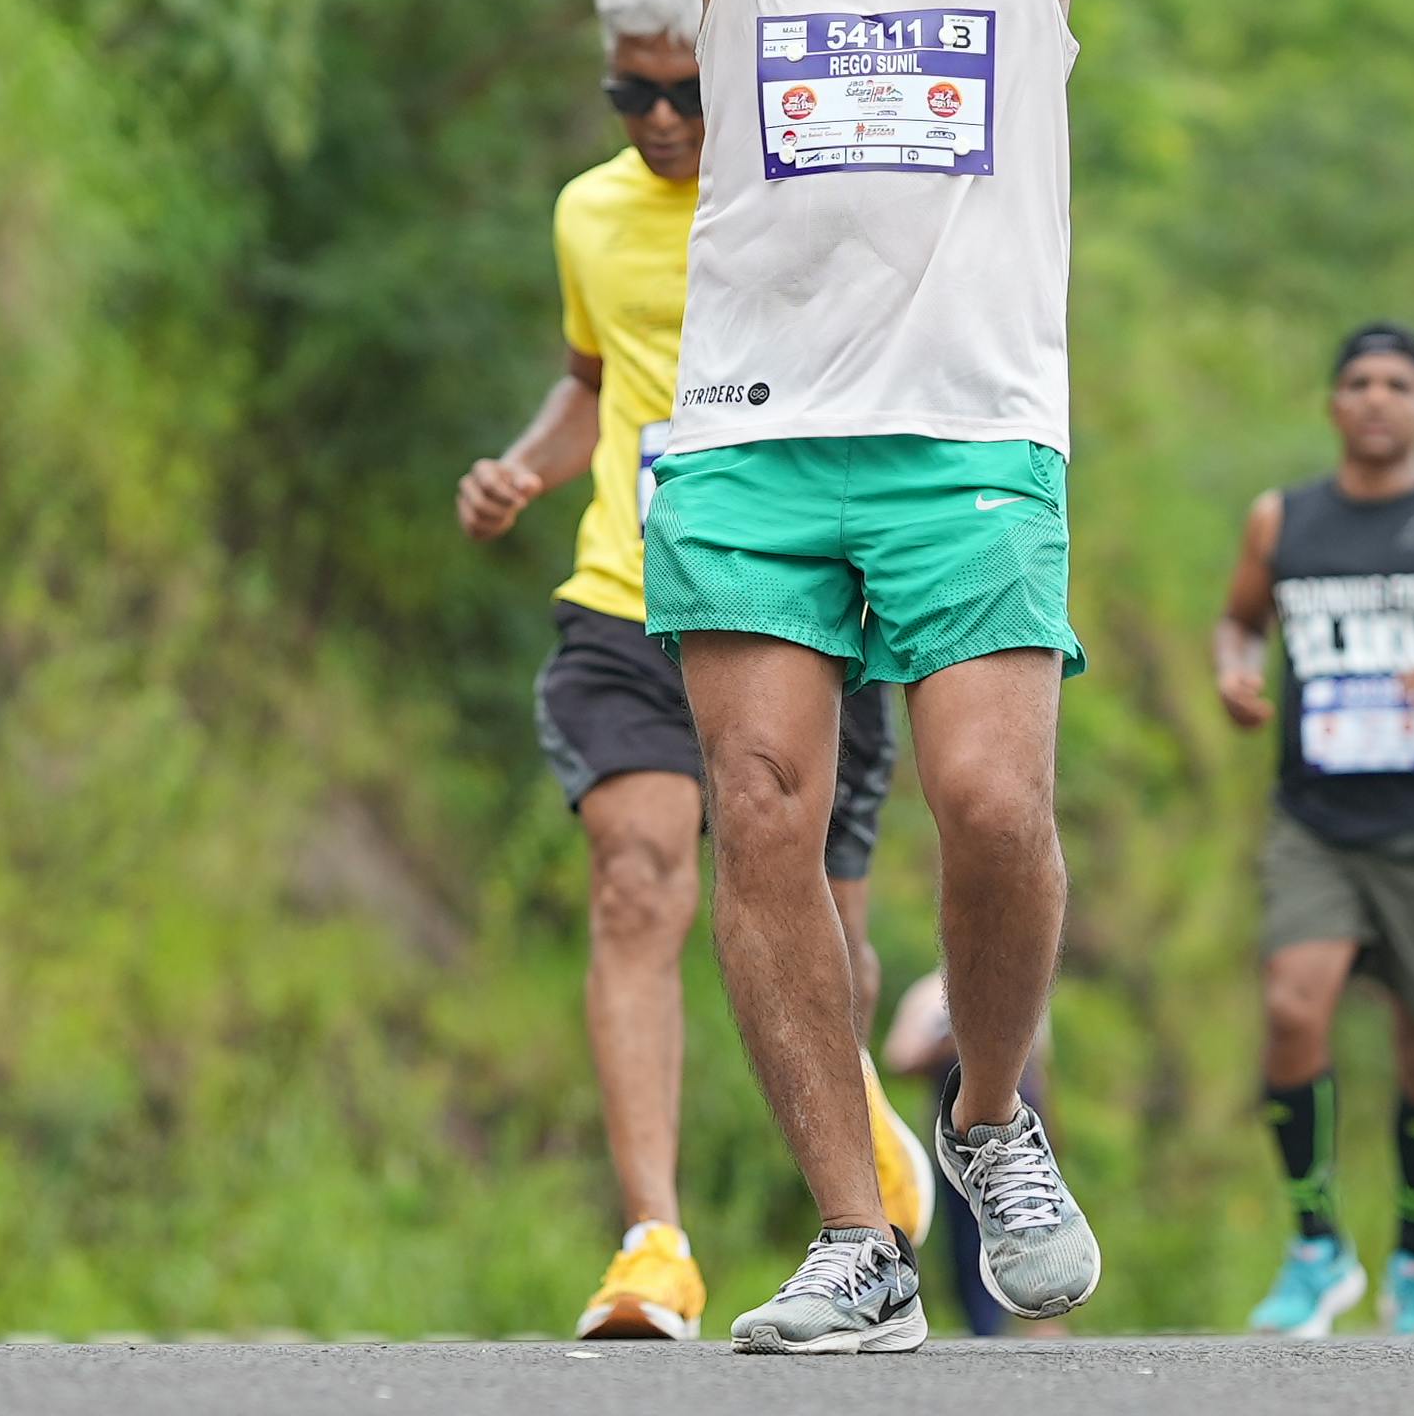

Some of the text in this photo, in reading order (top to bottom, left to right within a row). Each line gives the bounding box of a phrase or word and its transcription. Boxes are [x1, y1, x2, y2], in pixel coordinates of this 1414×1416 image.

[826, 19, 923, 50] 54111
[829, 53, 923, 75] REGO SUNIL
[682, 385, 745, 406] STRIDERS
